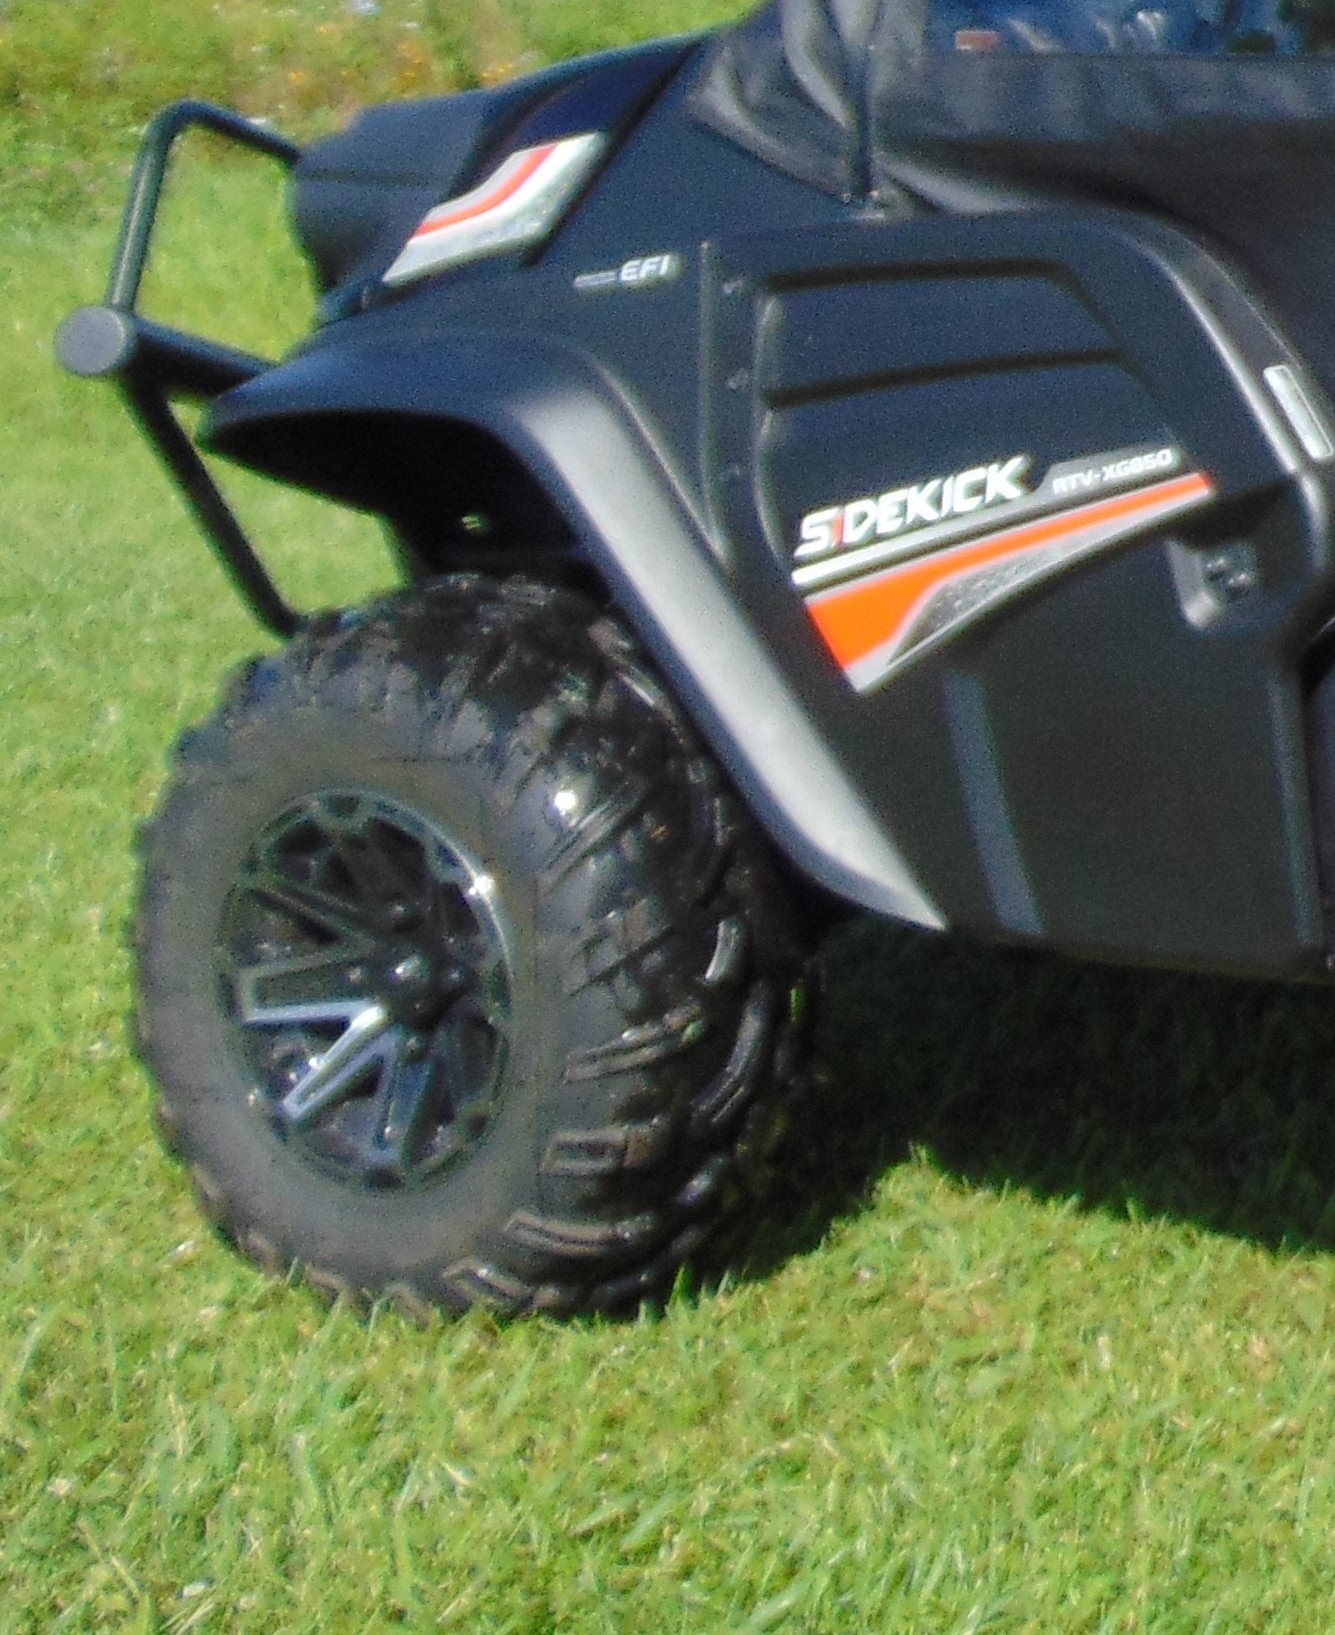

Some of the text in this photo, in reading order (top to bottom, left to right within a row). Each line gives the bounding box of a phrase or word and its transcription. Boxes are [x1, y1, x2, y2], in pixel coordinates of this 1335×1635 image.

[619, 254, 671, 282] EFI
[794, 447, 1173, 558] SIDEKICK RTV-XG850
